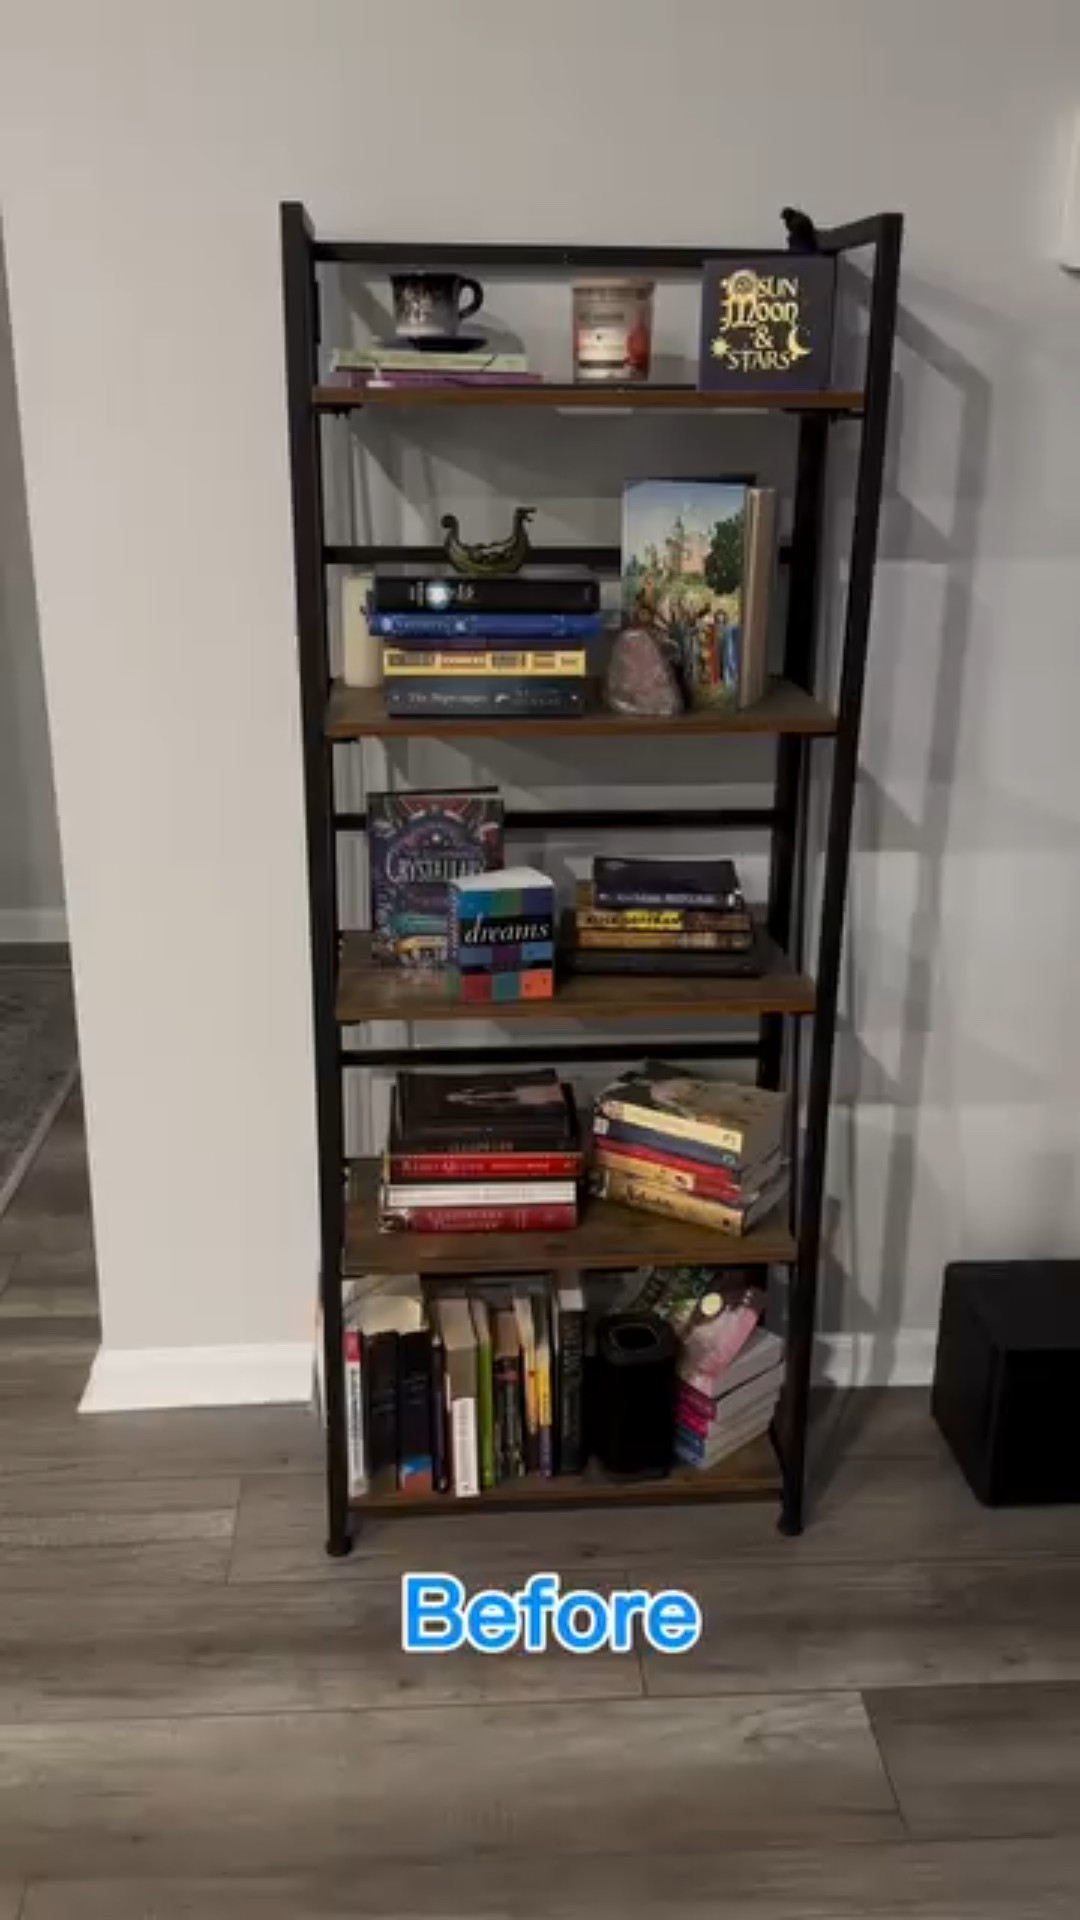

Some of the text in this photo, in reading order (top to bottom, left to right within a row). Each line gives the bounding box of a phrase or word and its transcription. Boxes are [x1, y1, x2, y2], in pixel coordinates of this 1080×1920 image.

[750, 324, 775, 350] &
[727, 349, 791, 373] STARS
[463, 911, 551, 944] dreams
